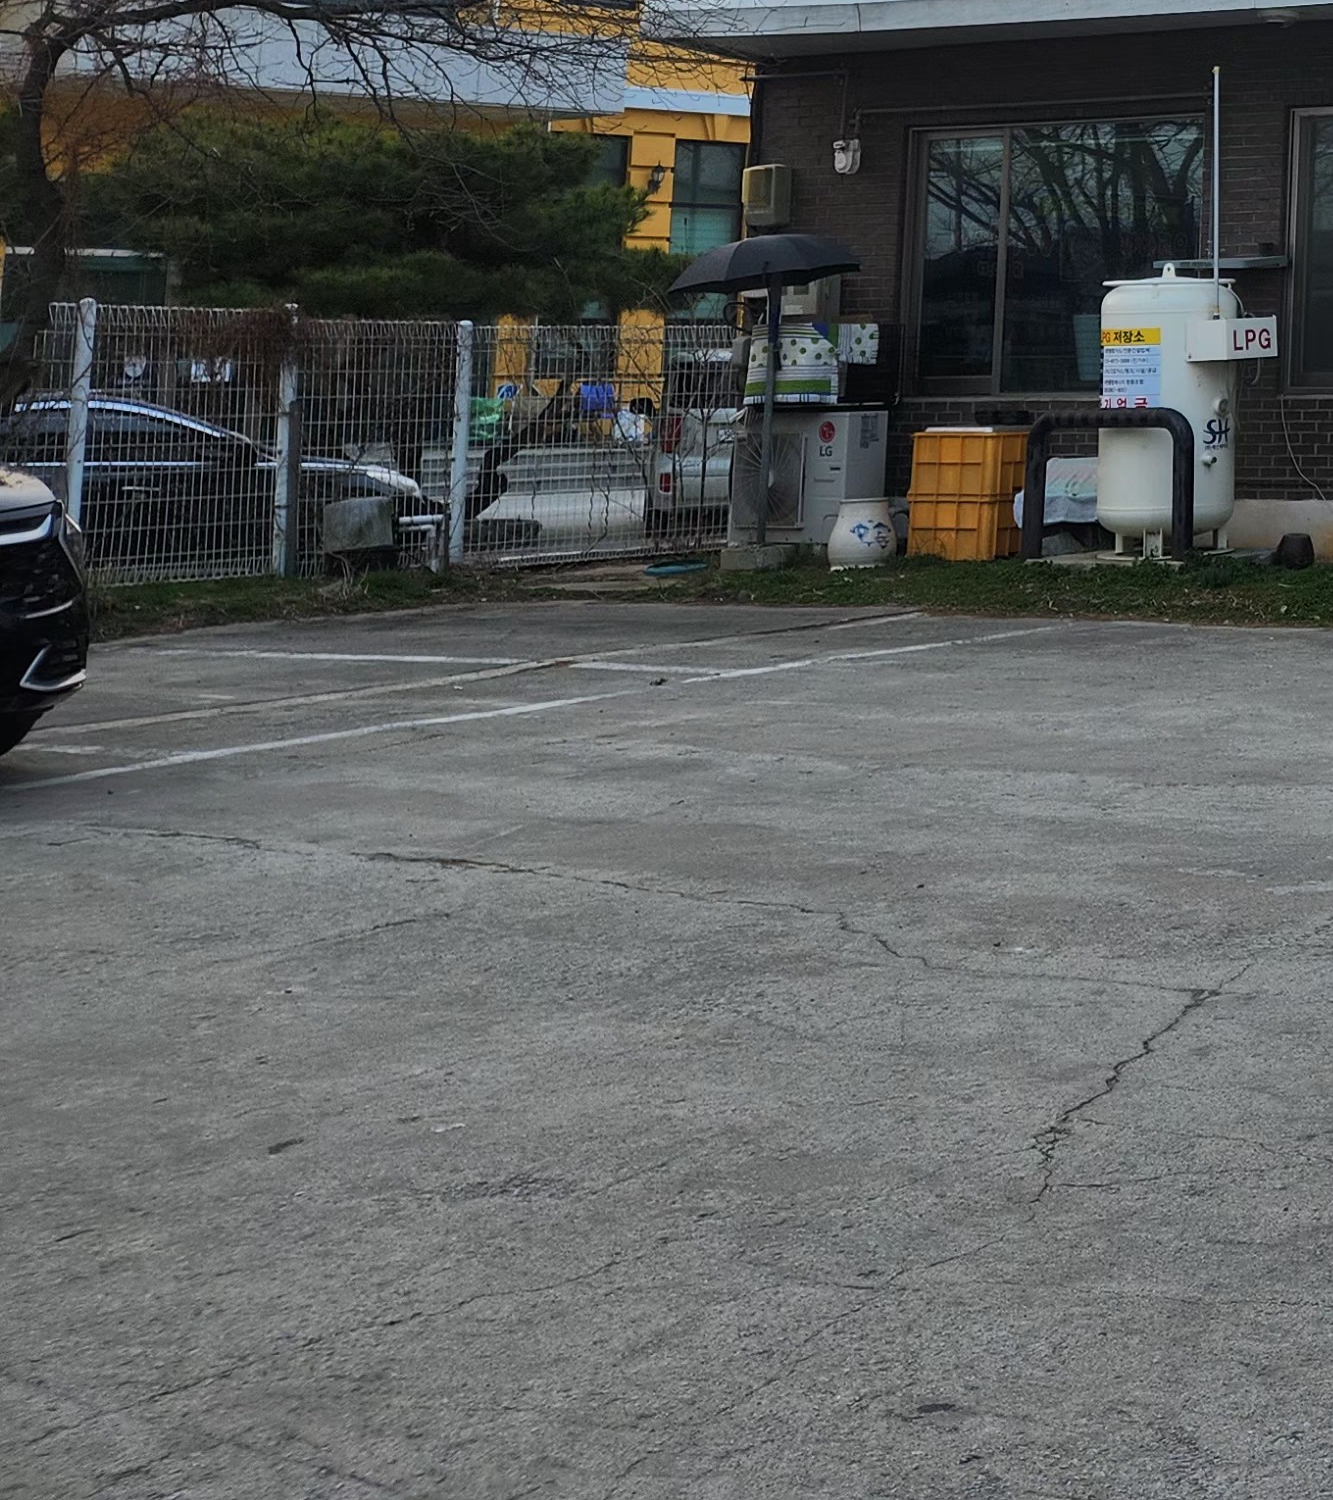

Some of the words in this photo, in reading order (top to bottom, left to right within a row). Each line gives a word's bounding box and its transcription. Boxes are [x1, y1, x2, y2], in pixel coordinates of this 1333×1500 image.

[1113, 330, 1145, 344] 저장소
[1232, 328, 1272, 351] LPG
[1202, 418, 1231, 445] SH
[819, 445, 833, 457] LG
